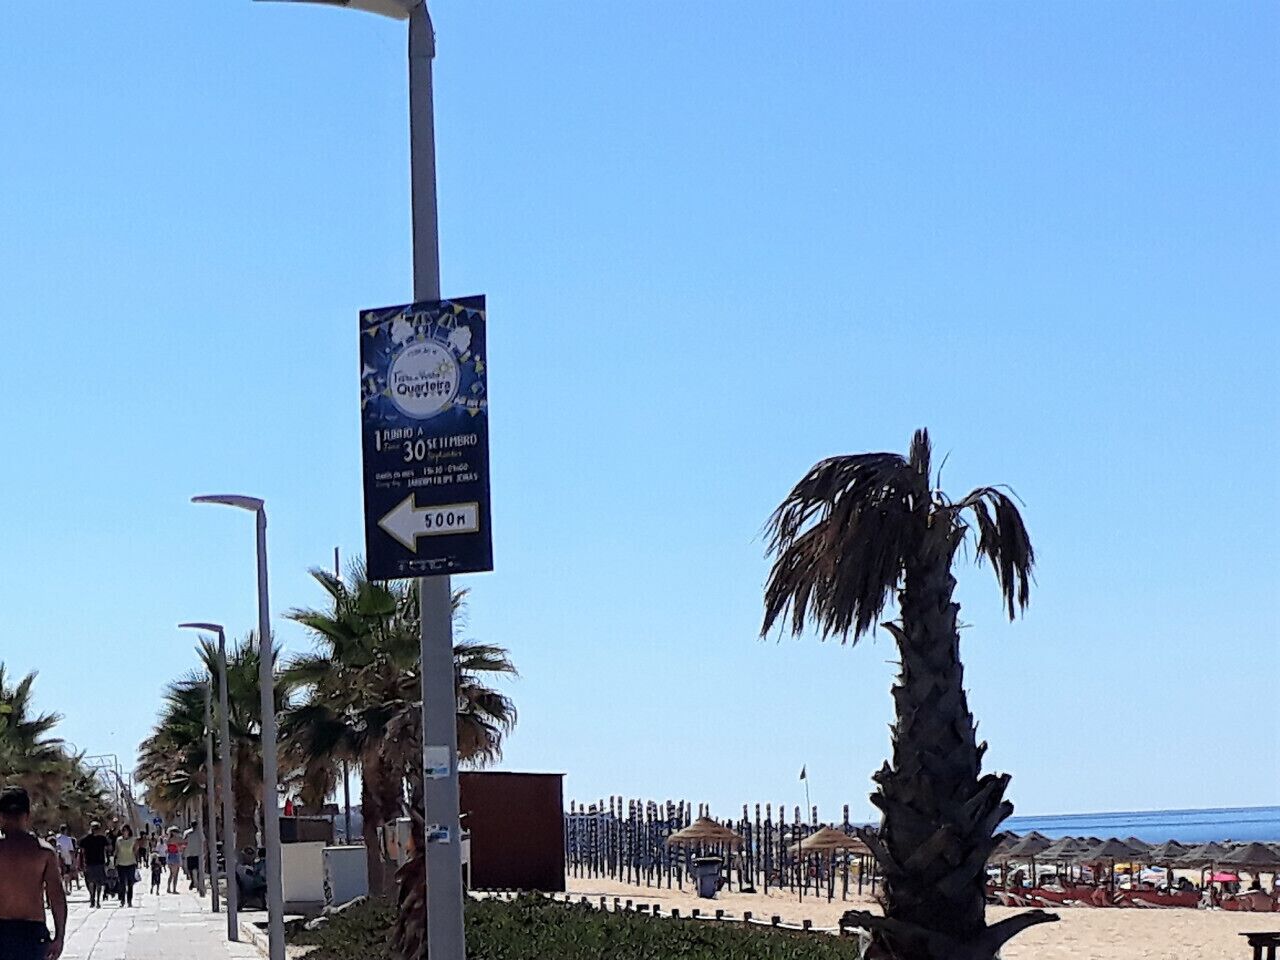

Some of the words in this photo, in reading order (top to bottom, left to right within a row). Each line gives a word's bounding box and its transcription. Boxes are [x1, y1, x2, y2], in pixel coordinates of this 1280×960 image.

[397, 381, 451, 395] Quarteira
[375, 430, 381, 451] 1
[403, 440, 426, 462] 30
